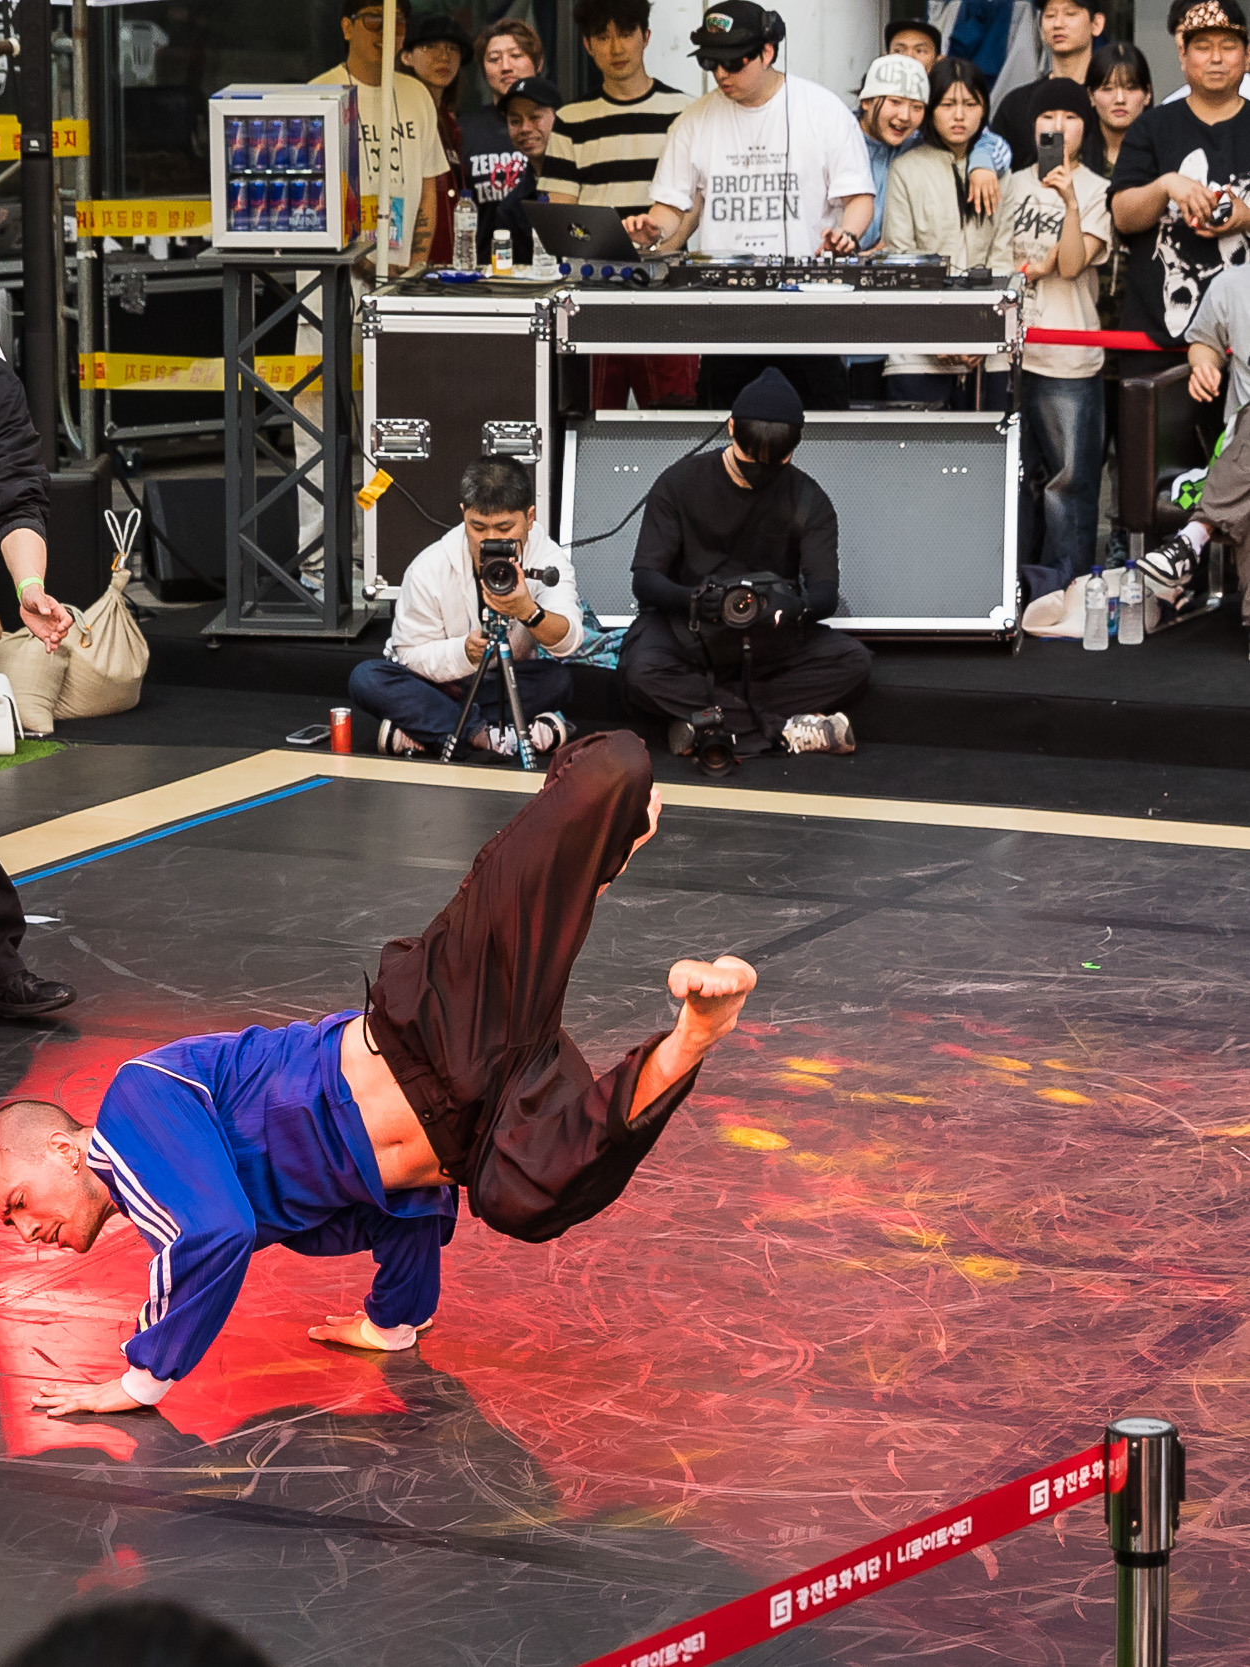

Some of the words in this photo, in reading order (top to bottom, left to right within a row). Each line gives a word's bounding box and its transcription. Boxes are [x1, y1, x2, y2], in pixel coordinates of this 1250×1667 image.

[712, 173, 799, 193] BROTHER
[712, 195, 799, 222] GREEN
[796, 1555, 881, 1611] 광진문화재단
